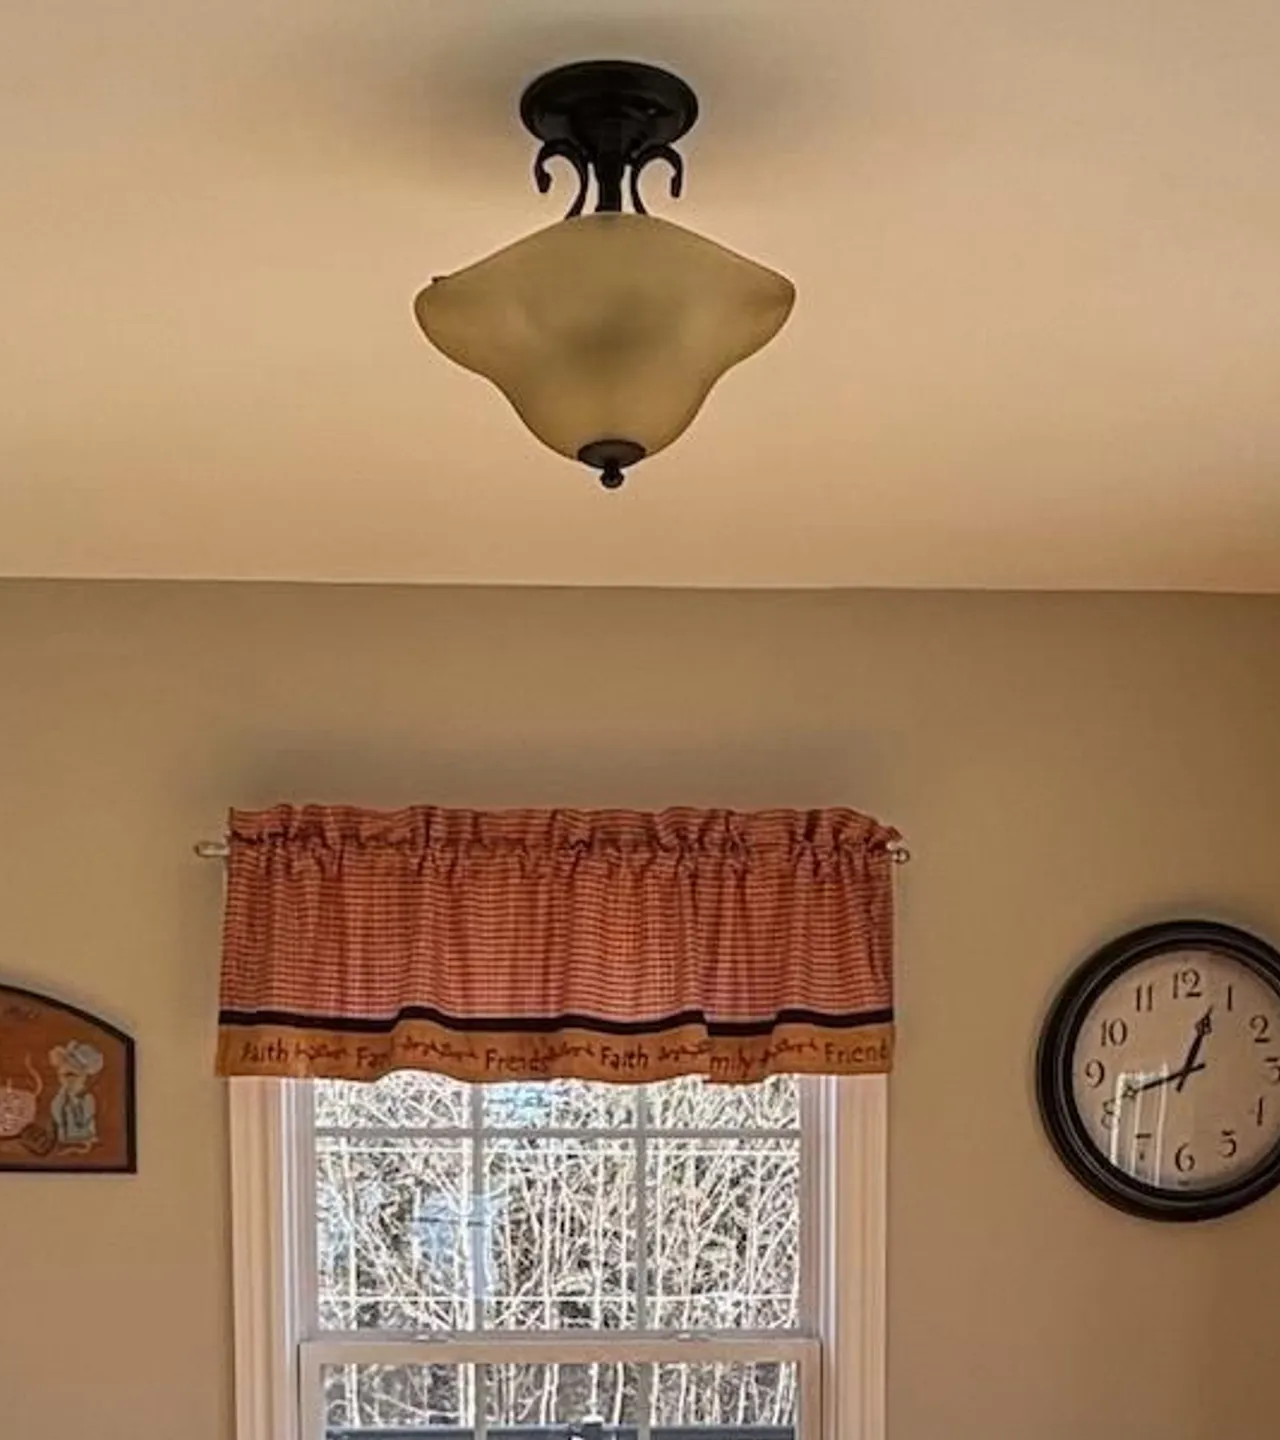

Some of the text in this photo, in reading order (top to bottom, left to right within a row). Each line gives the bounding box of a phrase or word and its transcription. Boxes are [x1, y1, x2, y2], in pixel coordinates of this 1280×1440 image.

[1135, 984, 1153, 1011] 11
[1172, 969, 1203, 999] 12
[1225, 984, 1233, 1011] 1
[1100, 1019, 1127, 1047] 10
[1249, 1014, 1271, 1043] 2
[599, 1043, 649, 1070] Faith
[1085, 1058, 1105, 1088] 9
[1175, 1142, 1195, 1173] 6
[1218, 1130, 1237, 1158] 5
